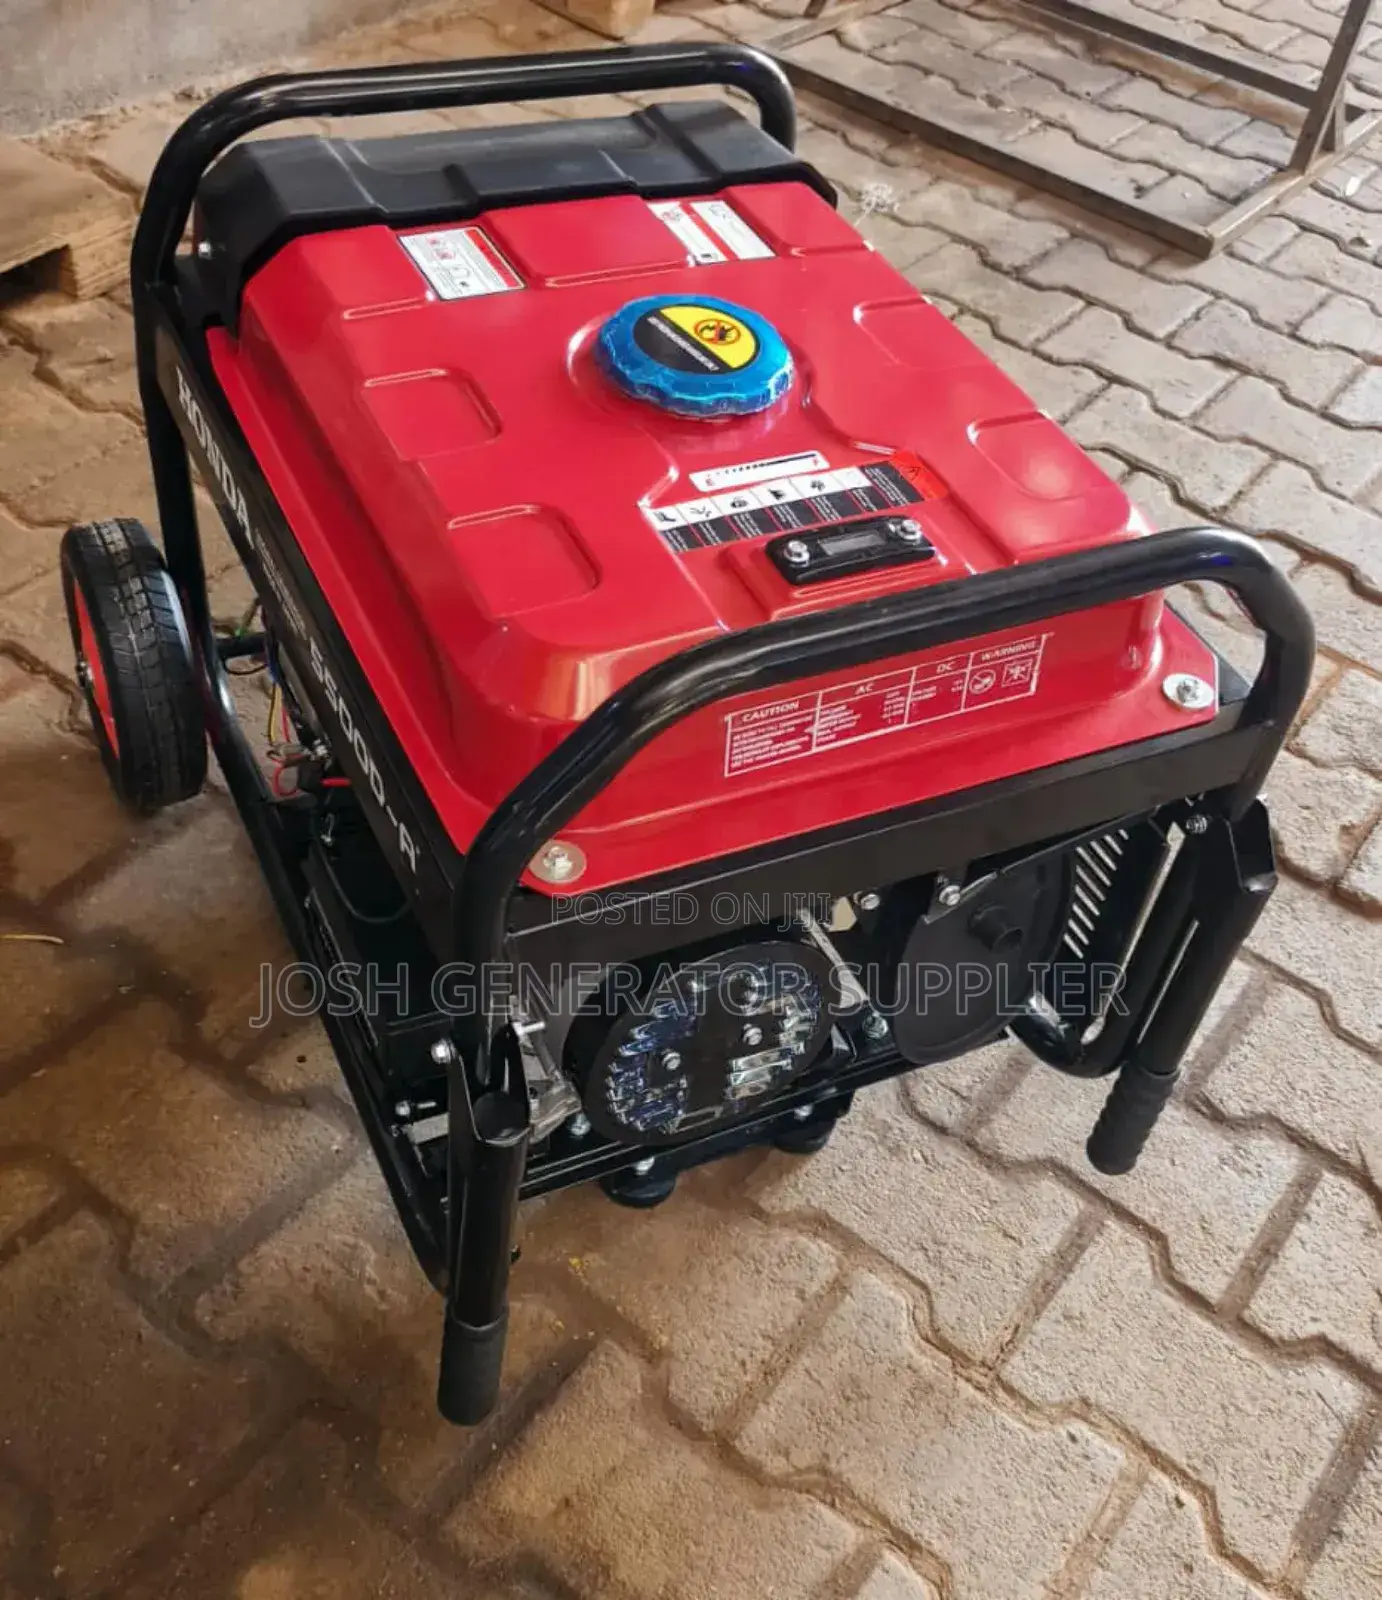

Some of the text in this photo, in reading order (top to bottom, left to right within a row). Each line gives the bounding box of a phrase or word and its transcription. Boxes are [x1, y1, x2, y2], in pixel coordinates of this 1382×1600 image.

[176, 365, 254, 551] HONDA
[936, 660, 956, 674] DC
[855, 682, 876, 696] AC
[742, 701, 799, 722] CAUTION
